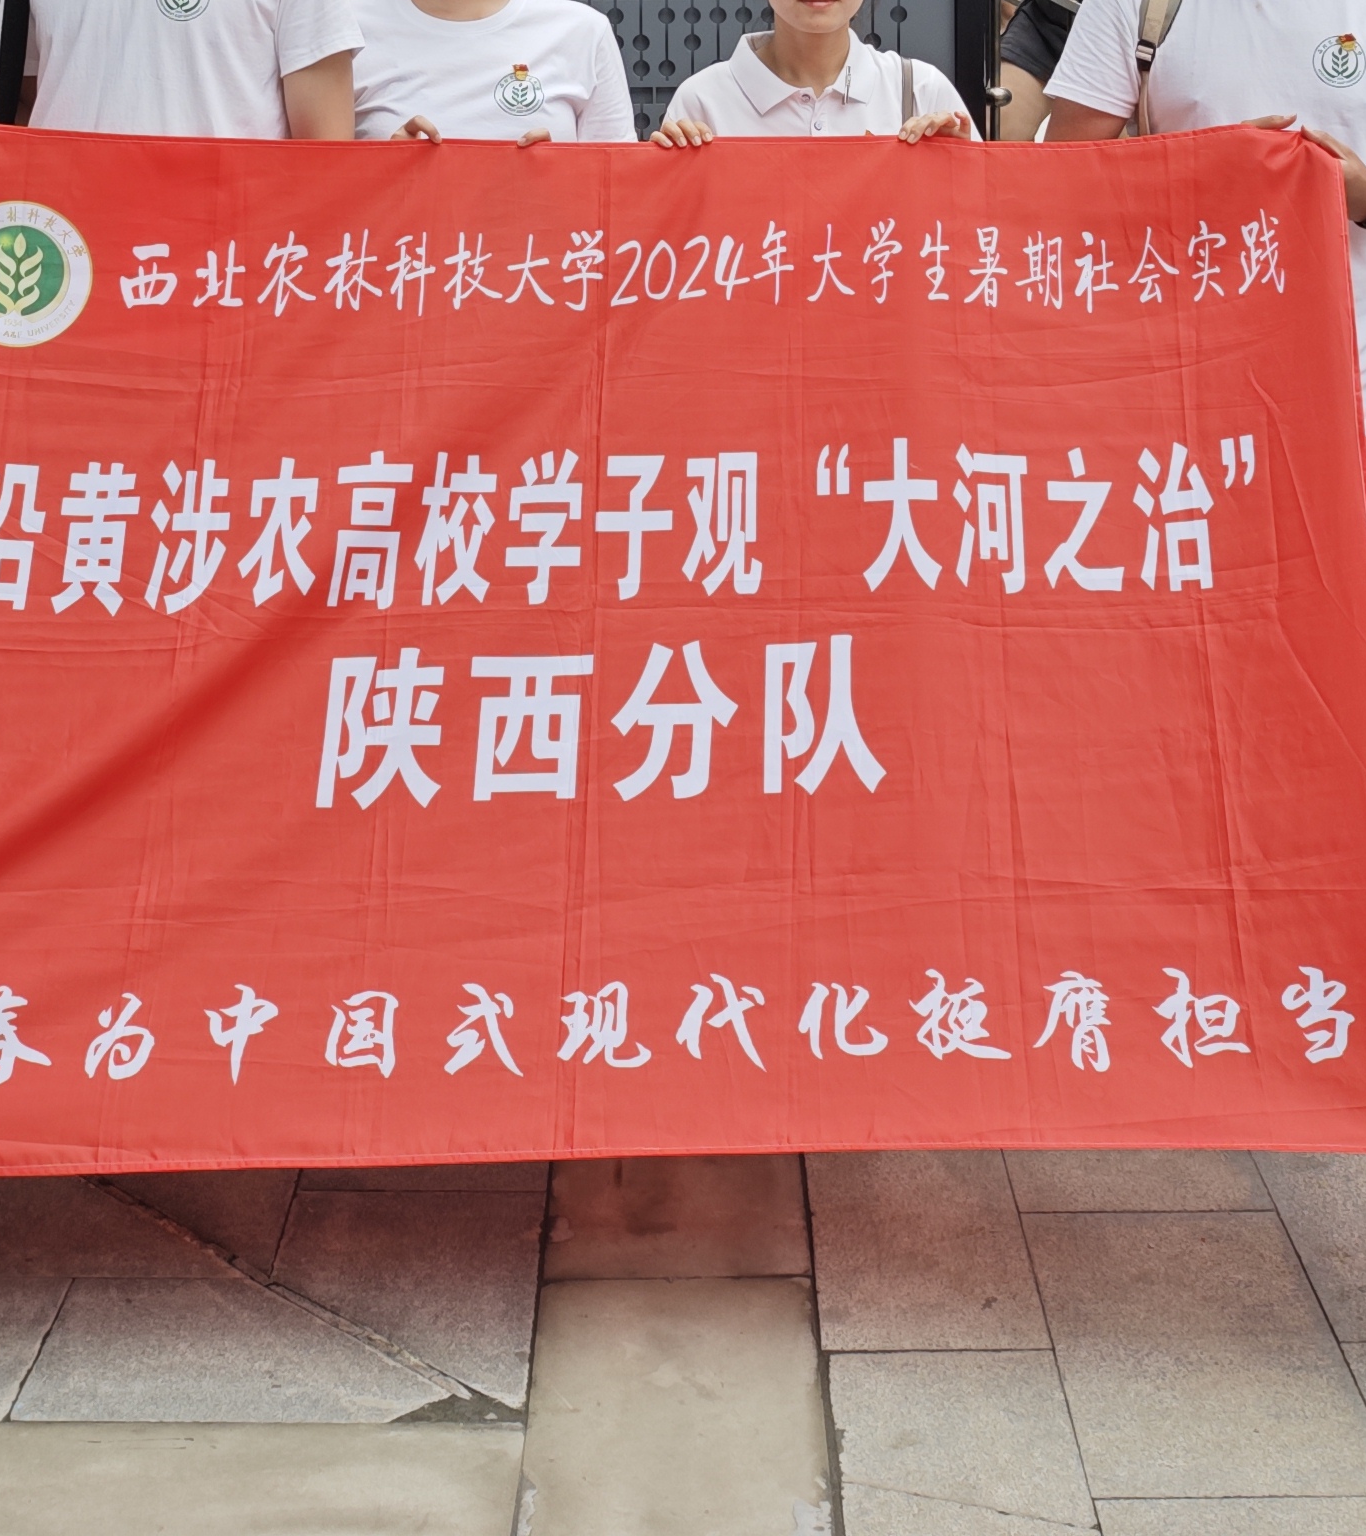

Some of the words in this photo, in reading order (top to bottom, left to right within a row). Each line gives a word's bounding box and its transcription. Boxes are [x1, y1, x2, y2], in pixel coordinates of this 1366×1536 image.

[119, 208, 1287, 318] 西北农林科技大学2024年大学生暑期社会实践
[316, 634, 888, 811] 陕西分队
